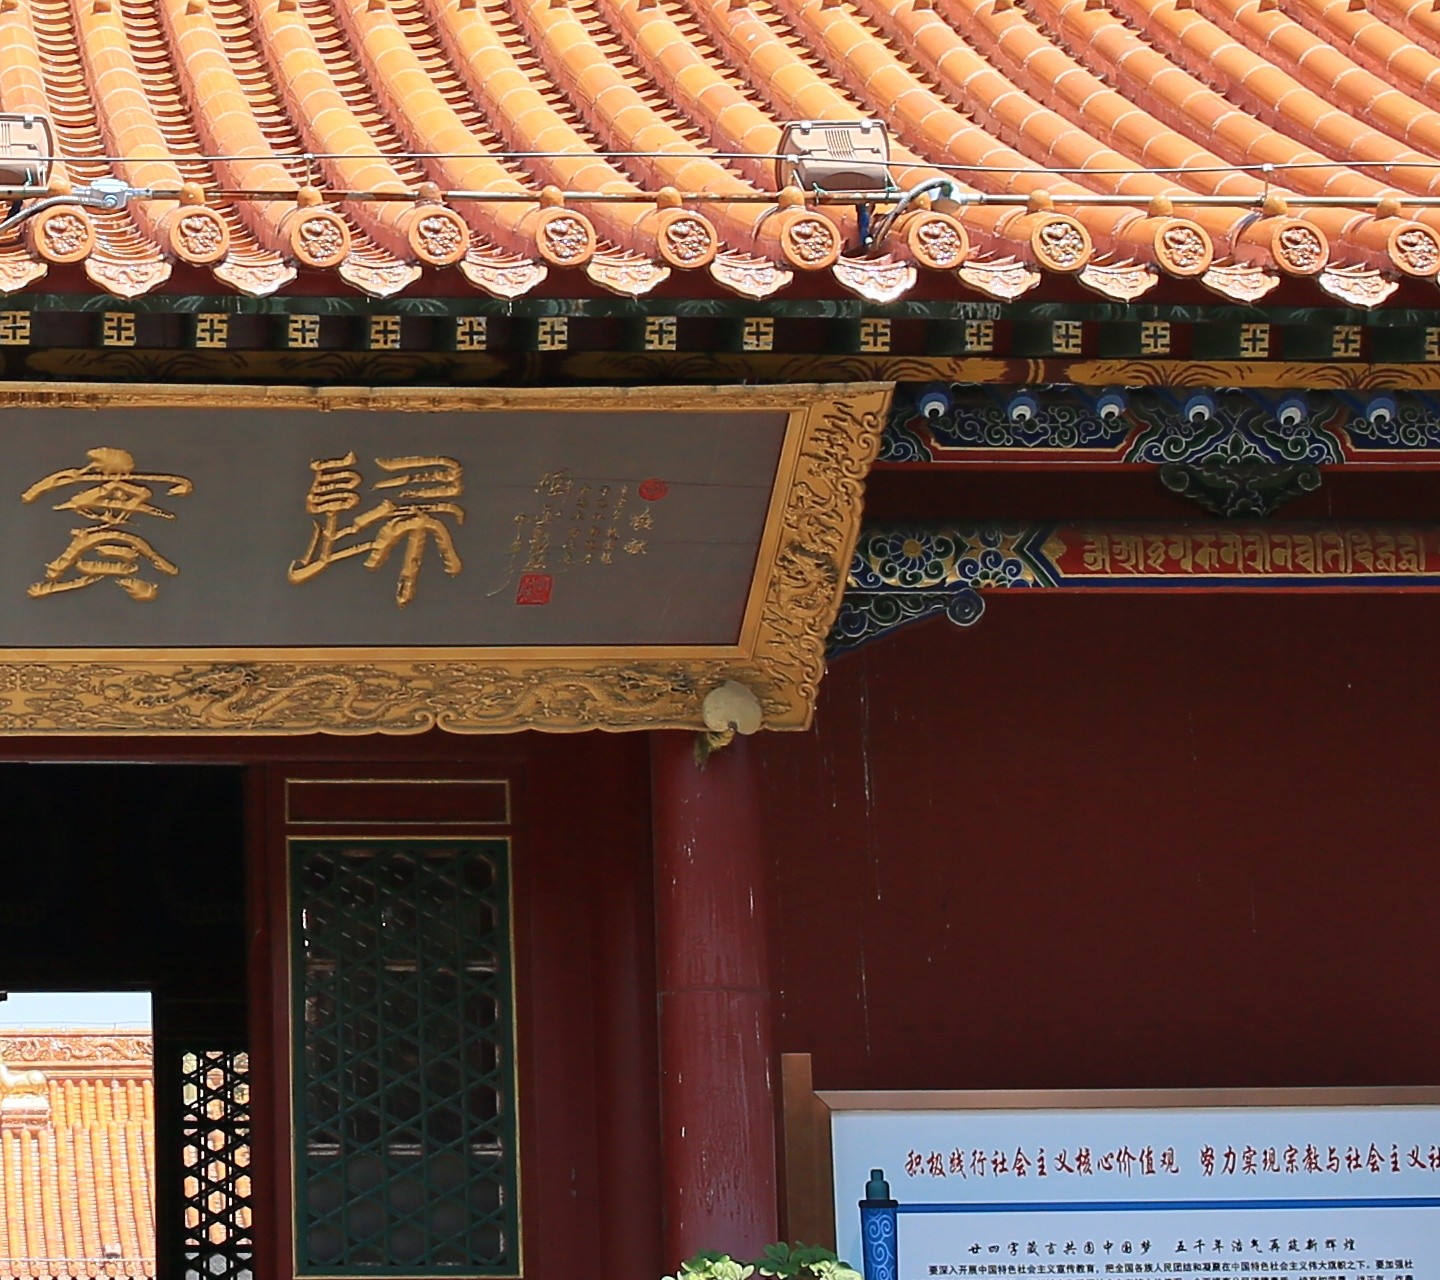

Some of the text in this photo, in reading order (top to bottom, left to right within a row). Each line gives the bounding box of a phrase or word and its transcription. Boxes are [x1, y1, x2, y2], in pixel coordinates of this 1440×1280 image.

[905, 1145, 1180, 1180] 积极践行社会主义核心价值观
[968, 1238, 1357, 1257] 廿四字箴言共圆中国梦 五千年浩气再筑新辉煌
